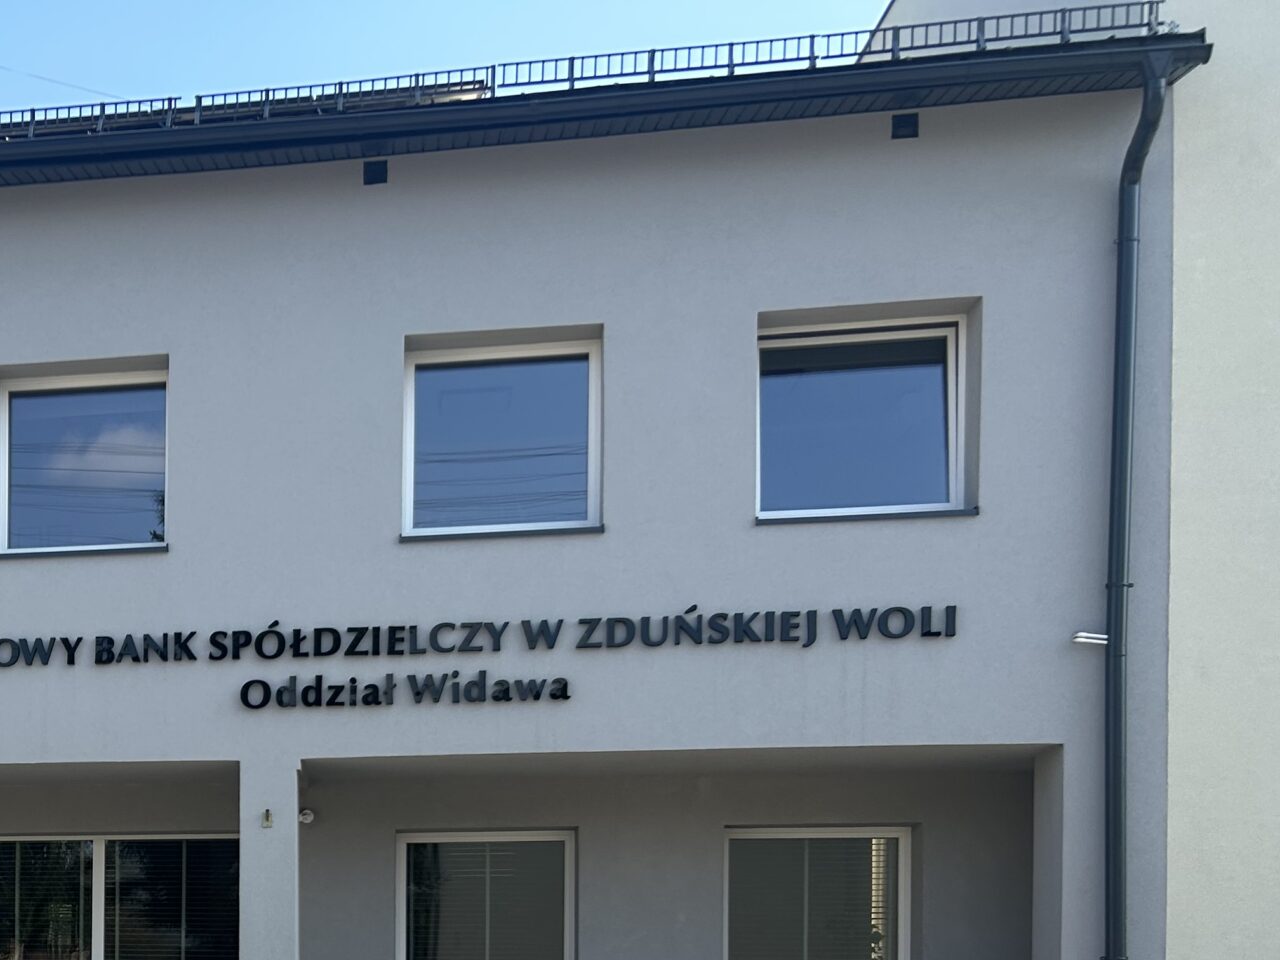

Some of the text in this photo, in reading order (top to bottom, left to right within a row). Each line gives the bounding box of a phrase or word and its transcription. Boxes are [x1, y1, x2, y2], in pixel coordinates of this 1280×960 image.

[95, 631, 196, 665] BANK
[208, 621, 509, 660] SPÓŁDZIELCZY
[521, 619, 563, 650] W
[576, 604, 818, 648] ZDUŃSKIEJ
[832, 605, 957, 640] WOLI
[240, 671, 571, 709] Oddział Widawa
